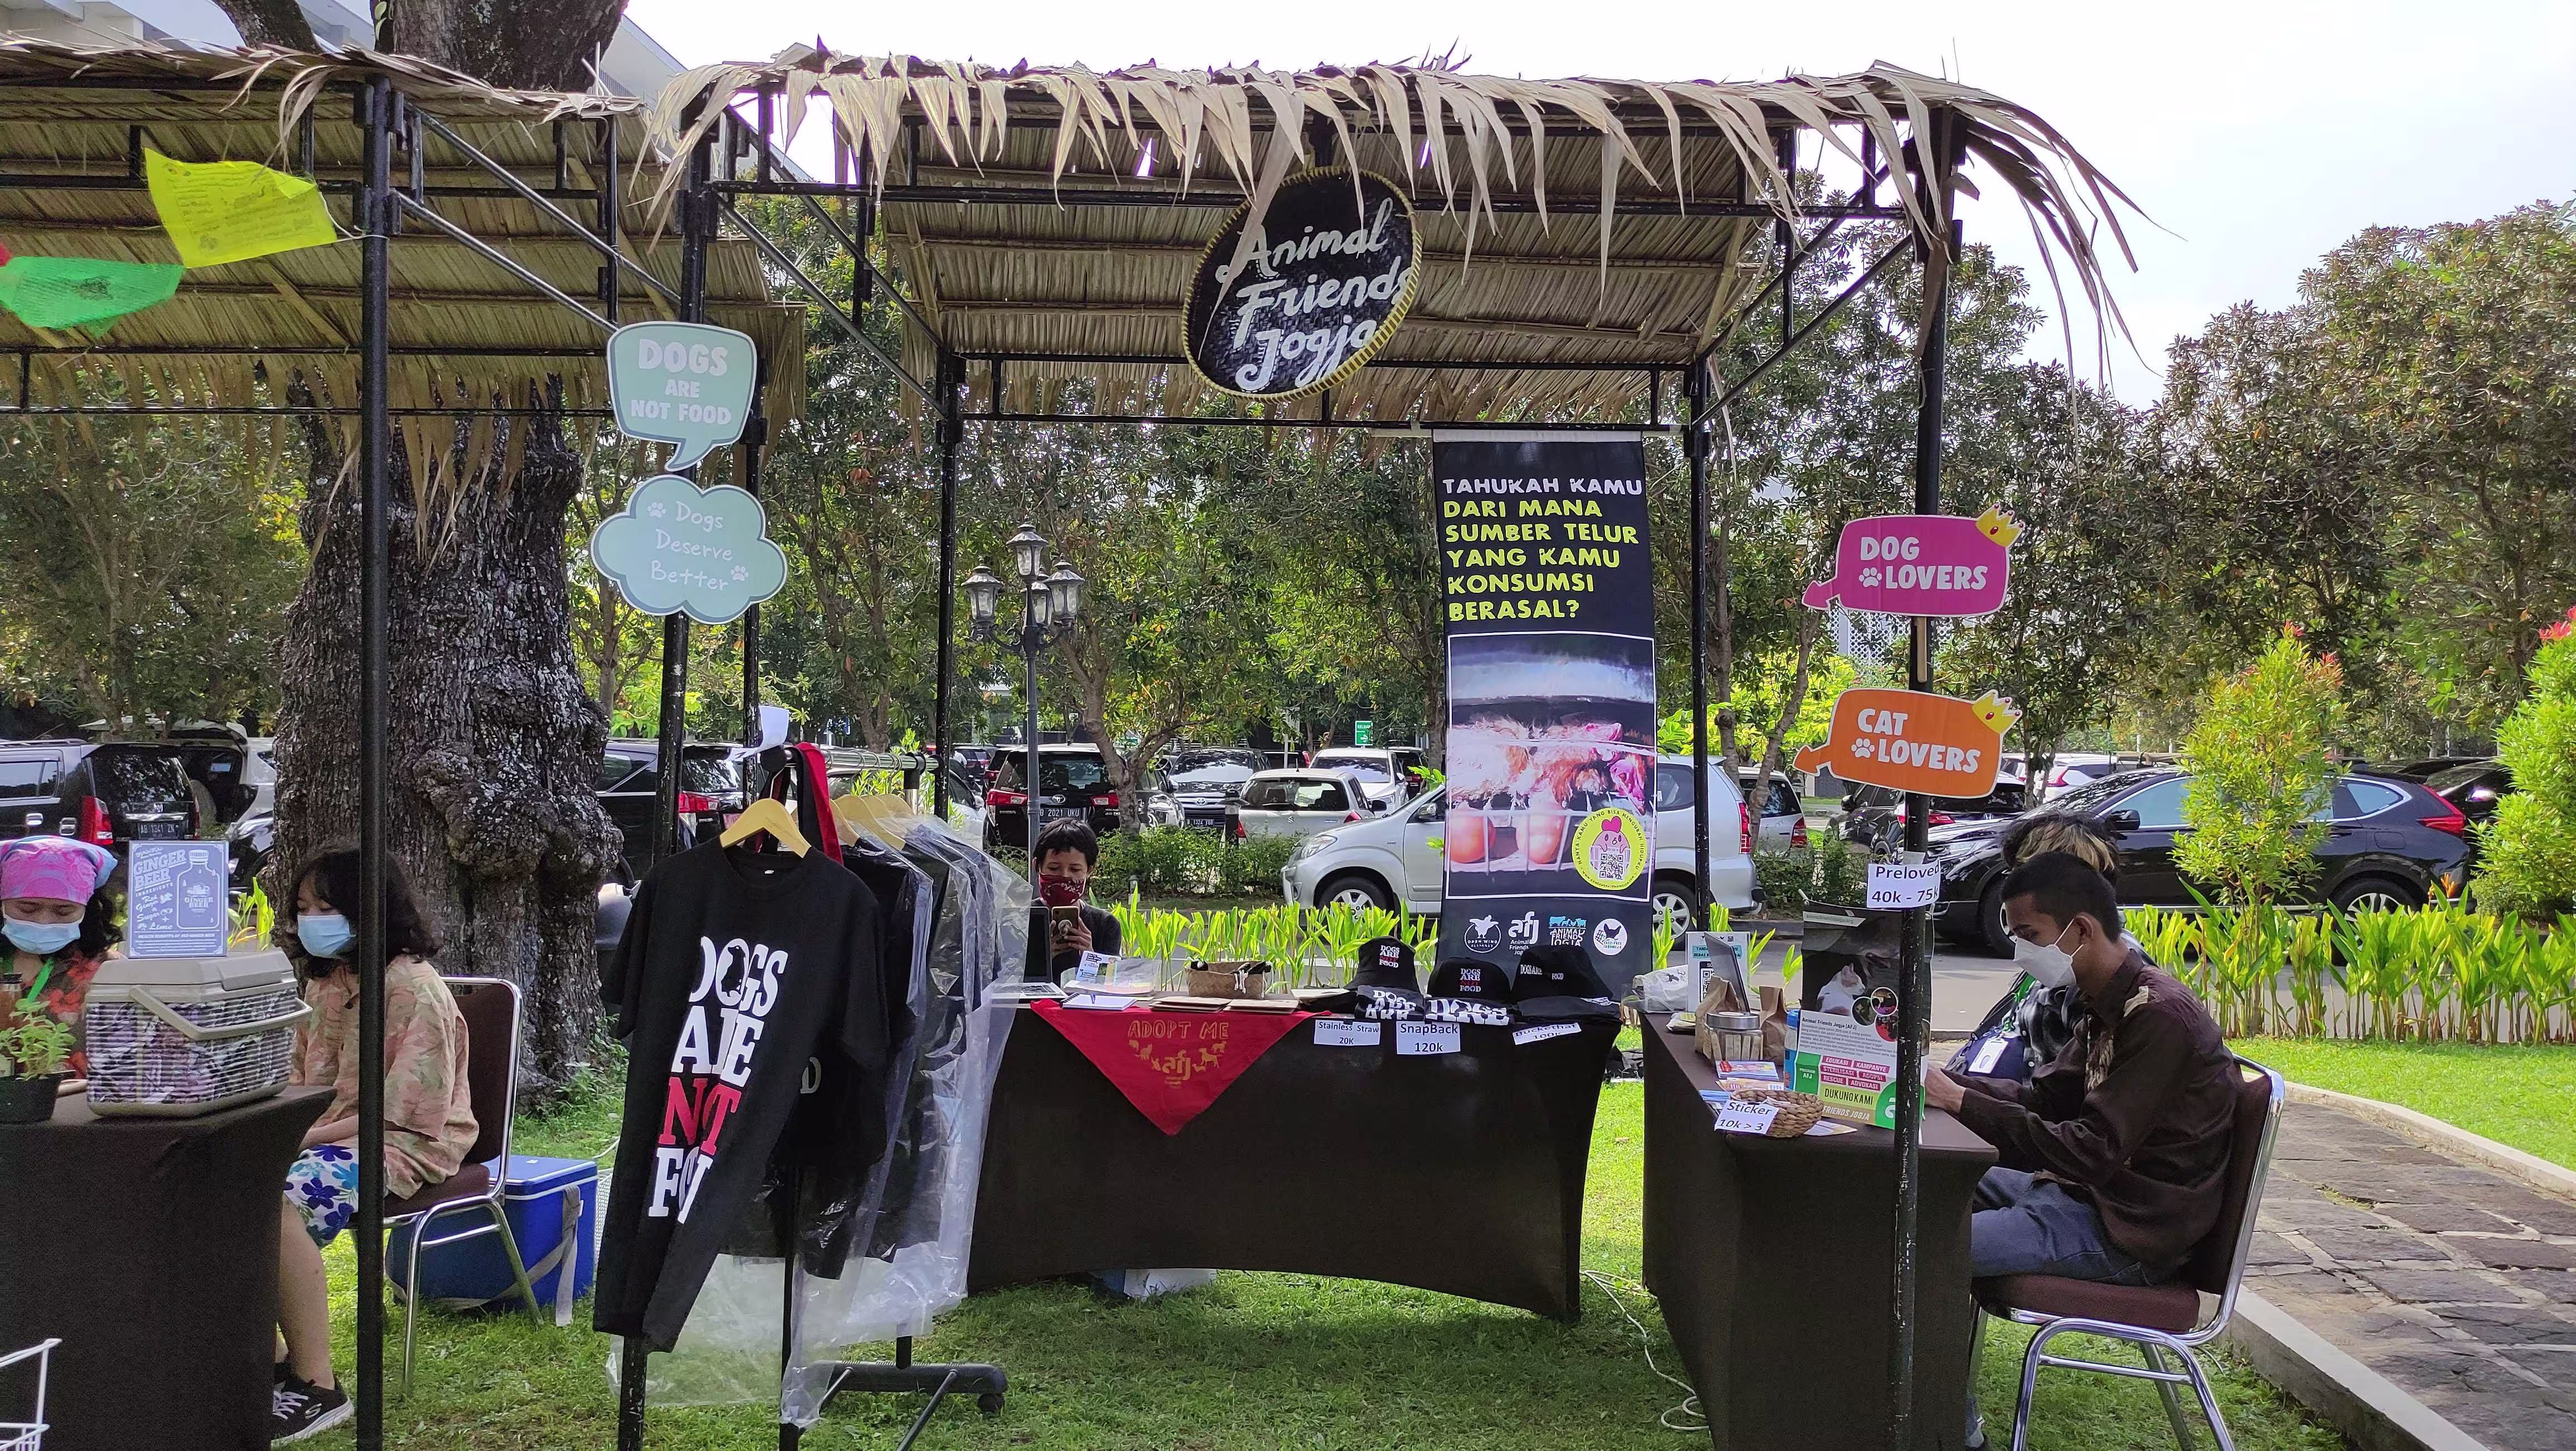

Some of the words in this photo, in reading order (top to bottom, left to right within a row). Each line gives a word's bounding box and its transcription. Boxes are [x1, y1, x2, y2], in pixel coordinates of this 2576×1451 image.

[1215, 197, 1393, 283] Animal
[638, 339, 728, 376] DOGS
[1235, 315, 1377, 391] Jogja
[665, 379, 700, 398] ARE
[631, 400, 670, 420] NOT
[679, 404, 731, 425] FOOD
[1442, 478, 1559, 494] TAHUKAH
[1570, 478, 1642, 495] KAMU
[675, 501, 724, 533] Dogs
[1443, 500, 1506, 518] DARI
[1519, 499, 1602, 517] MANA
[1445, 523, 1552, 542] SUMBER
[1564, 523, 1639, 544] TELUR
[656, 529, 733, 561] Deserve
[1860, 536, 1920, 561] DOG
[1446, 548, 1526, 568] YANG
[1539, 547, 1620, 568] KAMU
[650, 560, 729, 591] Better
[1447, 573, 1594, 595] KONSUMSI
[1885, 564, 1988, 590] LOVERS
[1449, 600, 1579, 621] BERASAL?
[1857, 708, 1908, 736] CAT
[1878, 738, 1981, 773] LOVERS
[140, 824, 148, 834] AB
[151, 824, 164, 833] 1341
[1577, 822, 1588, 840] KAMU
[1589, 811, 1605, 821] YANG
[134, 849, 187, 875] GINGER
[1876, 858, 1939, 880] Preloved
[135, 868, 170, 889] BEER
[136, 882, 173, 897] INGREDIENTS
[1872, 890, 1901, 903] 40k
[1918, 886, 1938, 902] 75k
[136, 900, 159, 912] Ginger
[137, 913, 160, 922] Sugar
[1508, 910, 1540, 944] afj
[1379, 959, 1399, 968] FOOD
[1380, 950, 1399, 958] ARE
[1520, 964, 1531, 974] DOGS
[1127, 1020, 1192, 1039] ADOPT
[1198, 1021, 1229, 1040] ME
[1319, 1021, 1353, 1031] Stainless
[1400, 1023, 1458, 1036] SnapBack
[1415, 1042, 1443, 1053] 120k
[1162, 1049, 1191, 1080] afj
[1823, 1066, 1855, 1077] STERILISASI
[1862, 1073, 1883, 1081] ADOPSI
[1825, 1057, 1848, 1066] EDUKASI
[1856, 1062, 1887, 1073] KAMPANYE
[1823, 1075, 1843, 1084] RESCUE
[1850, 1079, 1879, 1090] ADVOKASI
[1824, 1088, 1853, 1102] DUKUNG
[1854, 1093, 1874, 1105] KAMI
[1727, 1102, 1773, 1115] Sticker
[1822, 1105, 1850, 1117] FRIENDS
[1850, 1109, 1870, 1120] JOGJA
[1718, 1119, 1741, 1128] 10k
